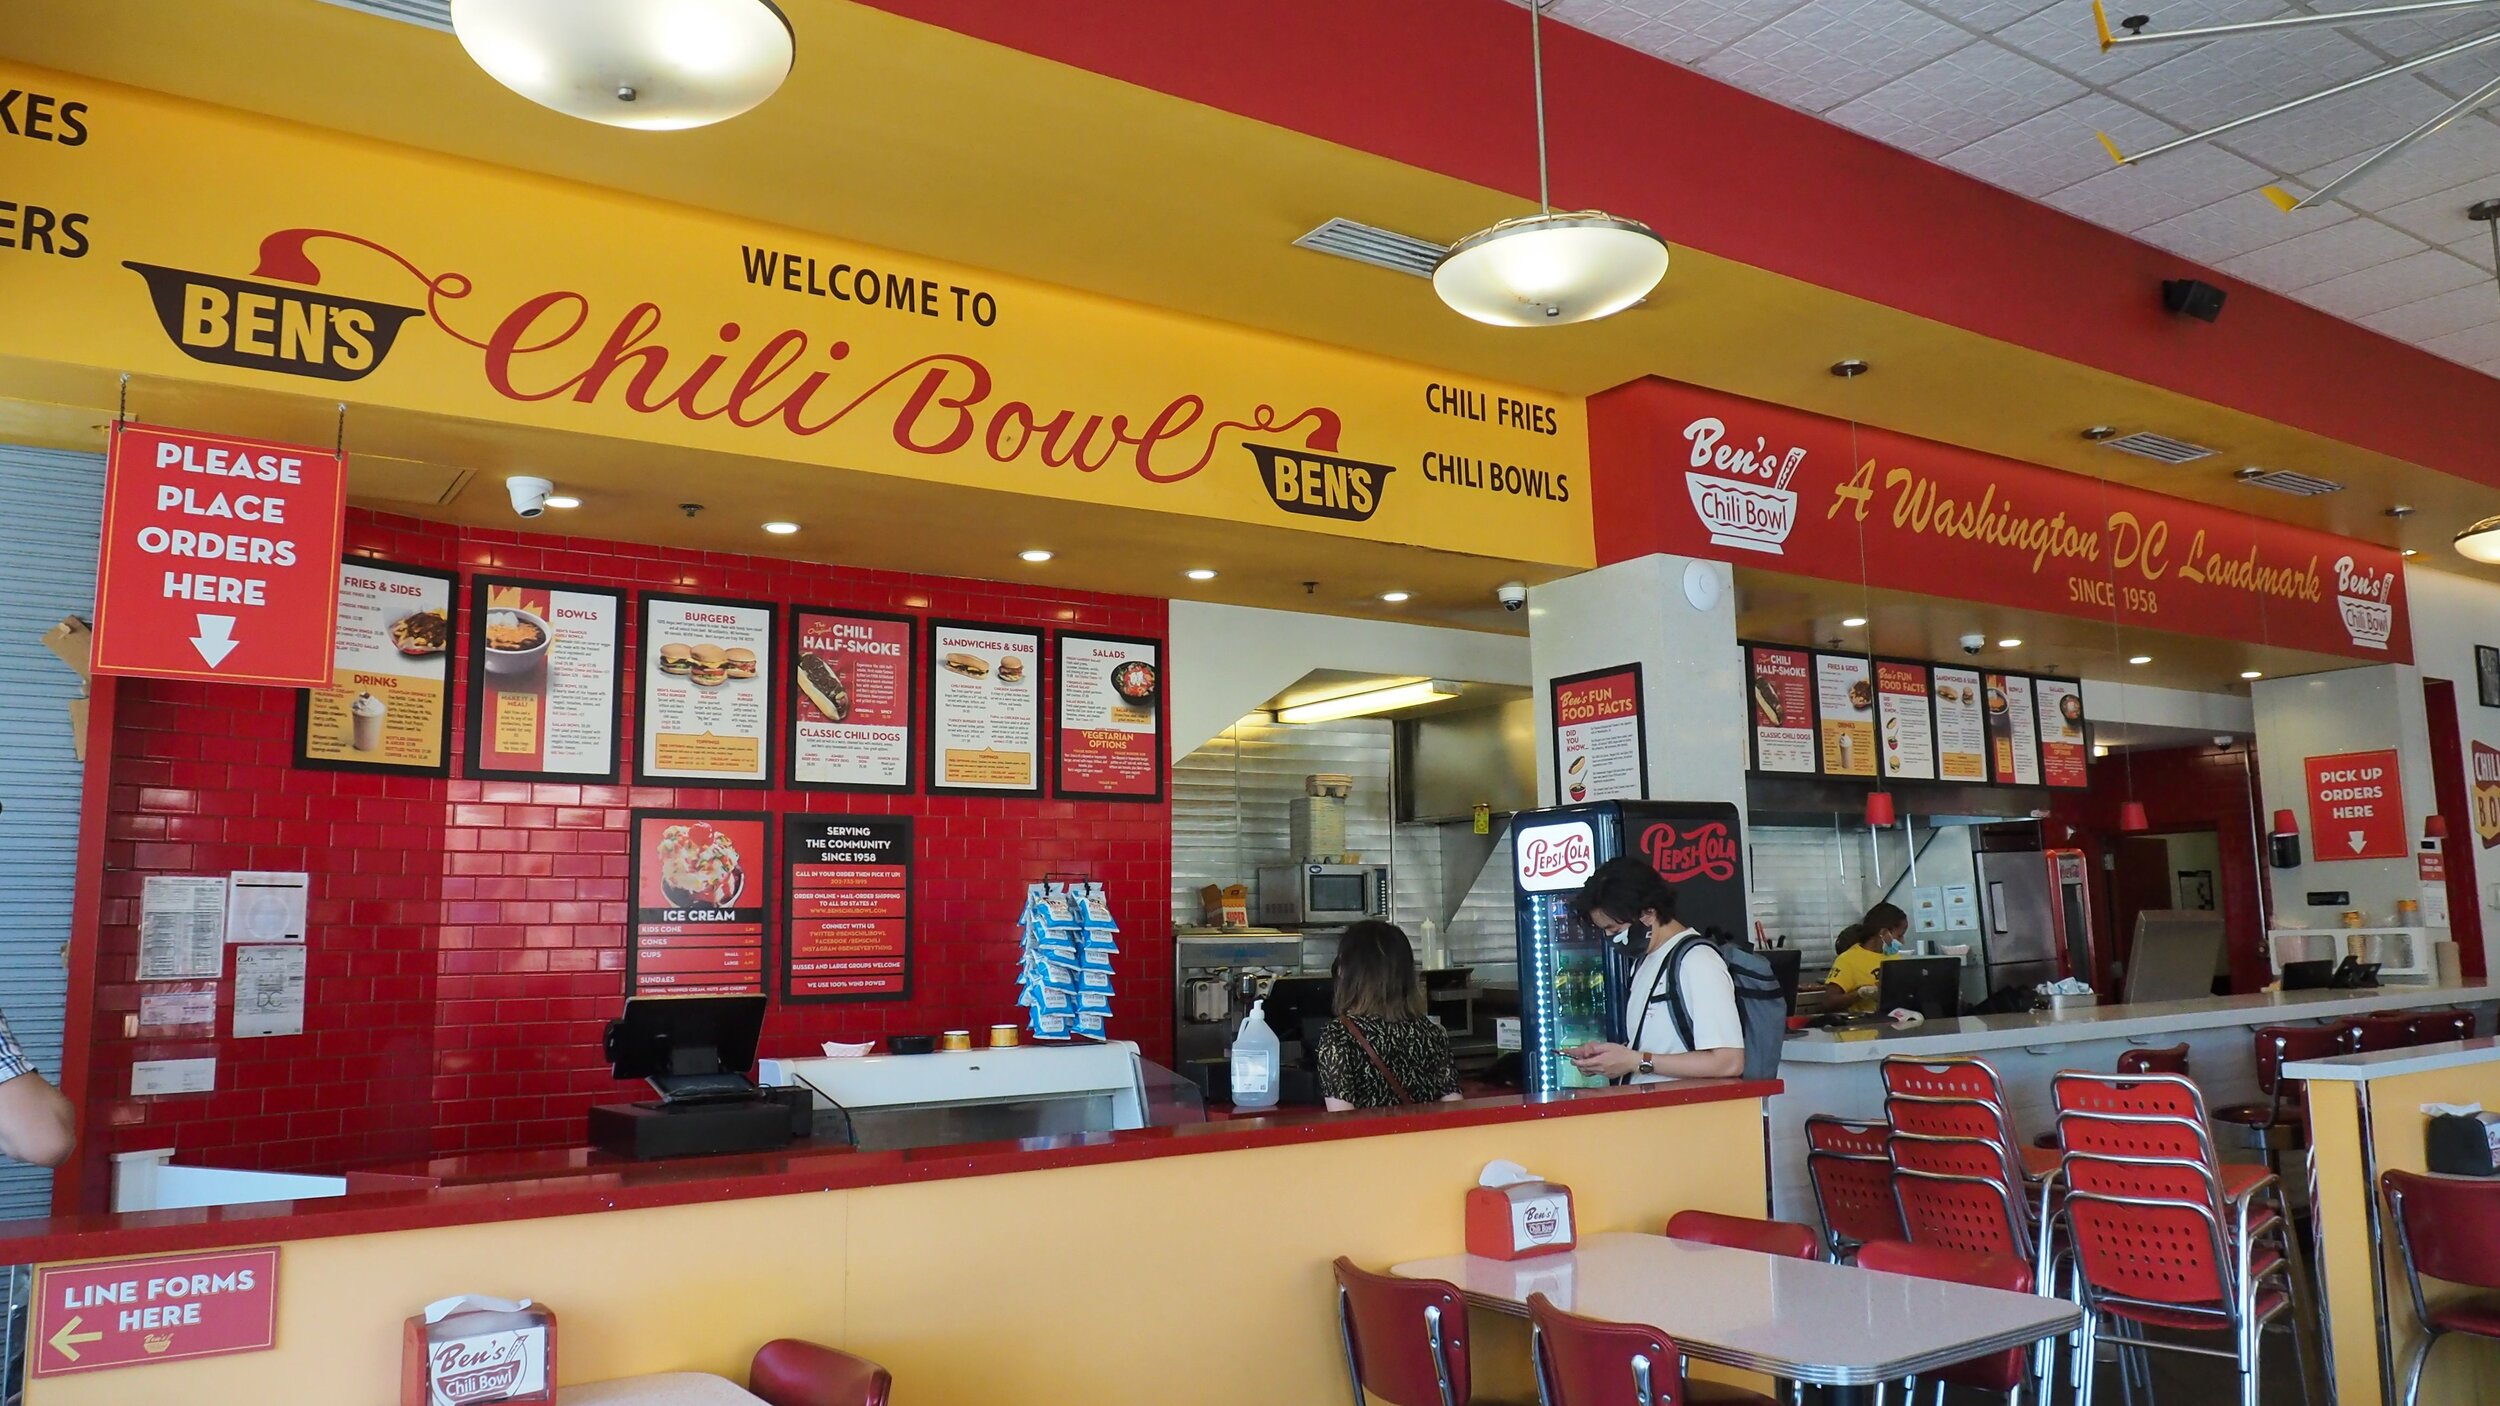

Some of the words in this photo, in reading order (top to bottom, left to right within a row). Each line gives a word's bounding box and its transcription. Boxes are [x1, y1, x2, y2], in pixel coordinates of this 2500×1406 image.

[741, 244, 939, 317] WELCOME
[950, 285, 997, 327] TO
[181, 282, 376, 371] BEN'S
[484, 290, 856, 436] Chili
[892, 353, 1209, 484] Bowl
[1425, 382, 1486, 422] CHILI
[1498, 396, 1558, 436] FRIES
[1682, 417, 1778, 479] Ben's
[155, 442, 302, 485] PLEASE
[1273, 455, 1374, 514] BEN'S
[1422, 451, 1484, 490] CHILI
[1490, 462, 1569, 503] BOWLS
[156, 485, 286, 525] PLACE
[1701, 492, 1742, 523] Chili
[1745, 499, 1787, 532] Bowl
[1827, 458, 1876, 522] A
[1885, 467, 2100, 574] Washington
[2108, 511, 2169, 581] DC
[2178, 529, 2322, 604] Landmark
[136, 526, 297, 567] ORDERS
[343, 576, 377, 590] FRIES
[378, 582, 387, 592] &
[389, 583, 422, 597] SIDES
[2333, 555, 2381, 597] Ben's
[162, 571, 267, 607] HERE
[2068, 576, 2116, 607] SINCE
[2122, 586, 2158, 614] 1958
[556, 609, 598, 621] BOWLS
[684, 611, 736, 625] BURGERS
[2345, 608, 2366, 630] Chili
[2365, 610, 2389, 633] Bowl
[832, 623, 873, 639] CHILI
[803, 635, 901, 656] HALF-SMOKE
[942, 637, 1002, 650] SANDWICHES
[1003, 642, 1010, 651] &
[1011, 643, 1034, 653] SUBS
[1092, 648, 1126, 659] SALADS
[1769, 654, 1791, 665] CHILI
[353, 674, 398, 688] DRINKS
[1756, 664, 1807, 677] HALF-SMOKE
[1877, 667, 1897, 680] Ben's
[1896, 671, 1912, 682] FUN
[1880, 680, 1902, 691] FOOD
[1903, 682, 1925, 693] FACTS
[1560, 690, 1588, 708] Ben's
[1588, 687, 1613, 703] FUN
[1561, 704, 1595, 721] FOOD
[1598, 698, 1633, 716] FACTS
[799, 728, 842, 739] CLASSIC
[843, 730, 870, 740] CHILI
[872, 732, 901, 742] DOGS
[1081, 731, 1134, 741] VEGETARIAN
[1565, 729, 1577, 737] DID
[1759, 731, 1781, 739] CLASSIC
[1781, 732, 1796, 740] CHILI
[1796, 733, 1811, 741] DOGS
[1088, 739, 1127, 749] OPTIONS
[2320, 769, 2358, 784] PICK
[2360, 767, 2383, 780] UP
[2320, 785, 2383, 802] ORDERS
[2333, 805, 2374, 819] HERE
[2478, 796, 2500, 828] BO
[826, 826, 871, 836] SERVING
[805, 838, 827, 848] THE
[827, 839, 891, 850] COMMUNITY
[821, 852, 852, 862] SINCE
[853, 853, 877, 862] 1958
[663, 910, 686, 921] ICE
[688, 910, 736, 921] CREAM
[640, 976, 675, 984] SUNDAES
[1525, 1206, 1552, 1221] Ben's
[64, 1280, 139, 1310] LINE
[147, 1269, 256, 1301] FORMS
[118, 1302, 203, 1333] HERE
[435, 1339, 506, 1374] Ben's
[445, 1378, 476, 1397] Chili
[479, 1368, 512, 1390] Bowl
